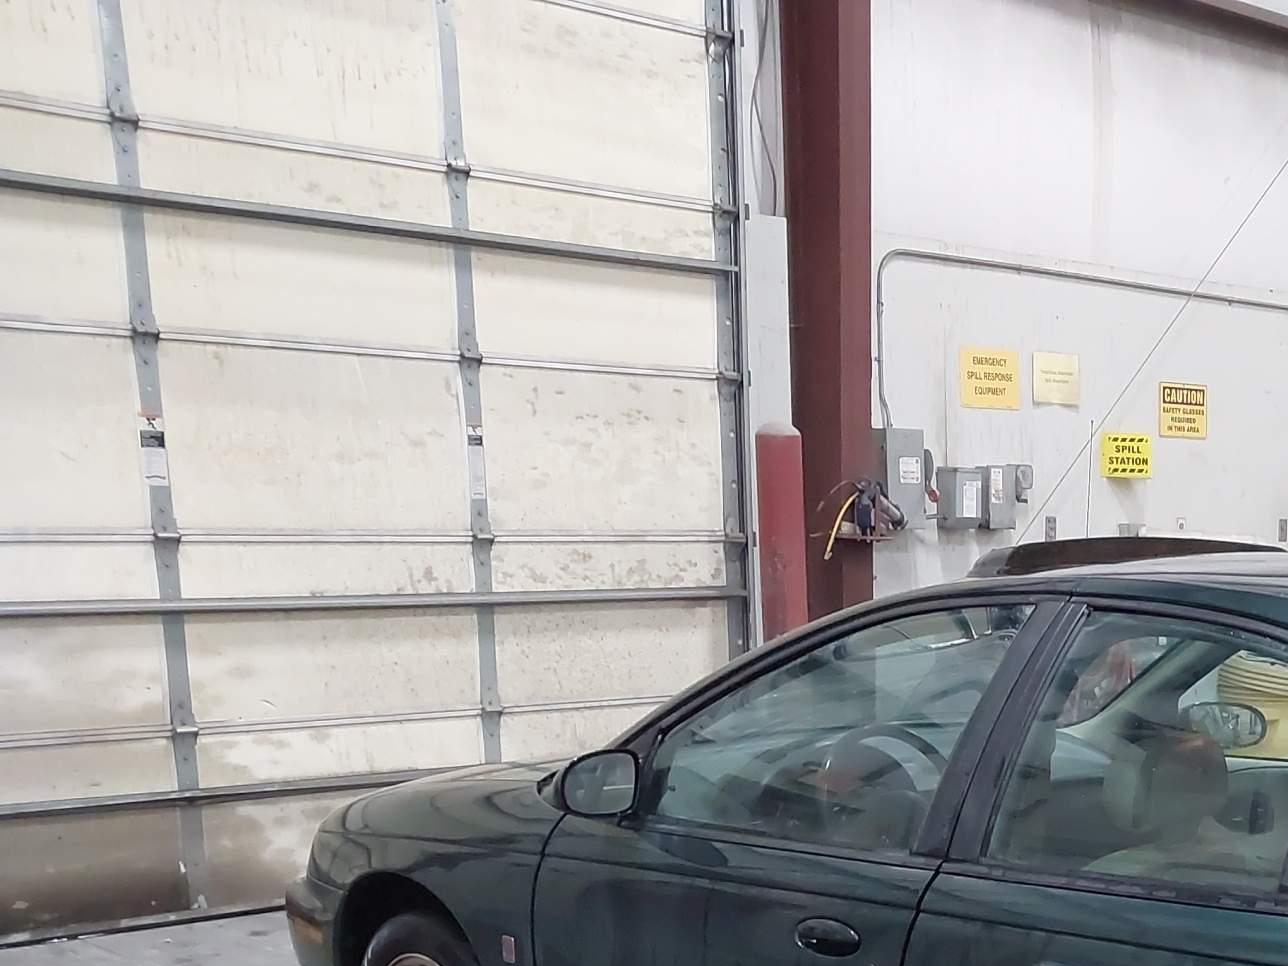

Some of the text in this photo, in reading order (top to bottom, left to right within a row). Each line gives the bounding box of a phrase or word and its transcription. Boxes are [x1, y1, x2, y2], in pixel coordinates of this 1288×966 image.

[972, 356, 1007, 367] EMERGENCY
[967, 370, 1013, 382] SPILL RESPONSE
[975, 386, 1006, 396] EQUIPMENT
[1164, 388, 1204, 405] CAUTION
[1163, 406, 1205, 416] SAFETY GLASSES
[1170, 416, 1196, 424] REQUIRED
[1115, 445, 1142, 454] SPILL
[1108, 456, 1148, 466] STATION
